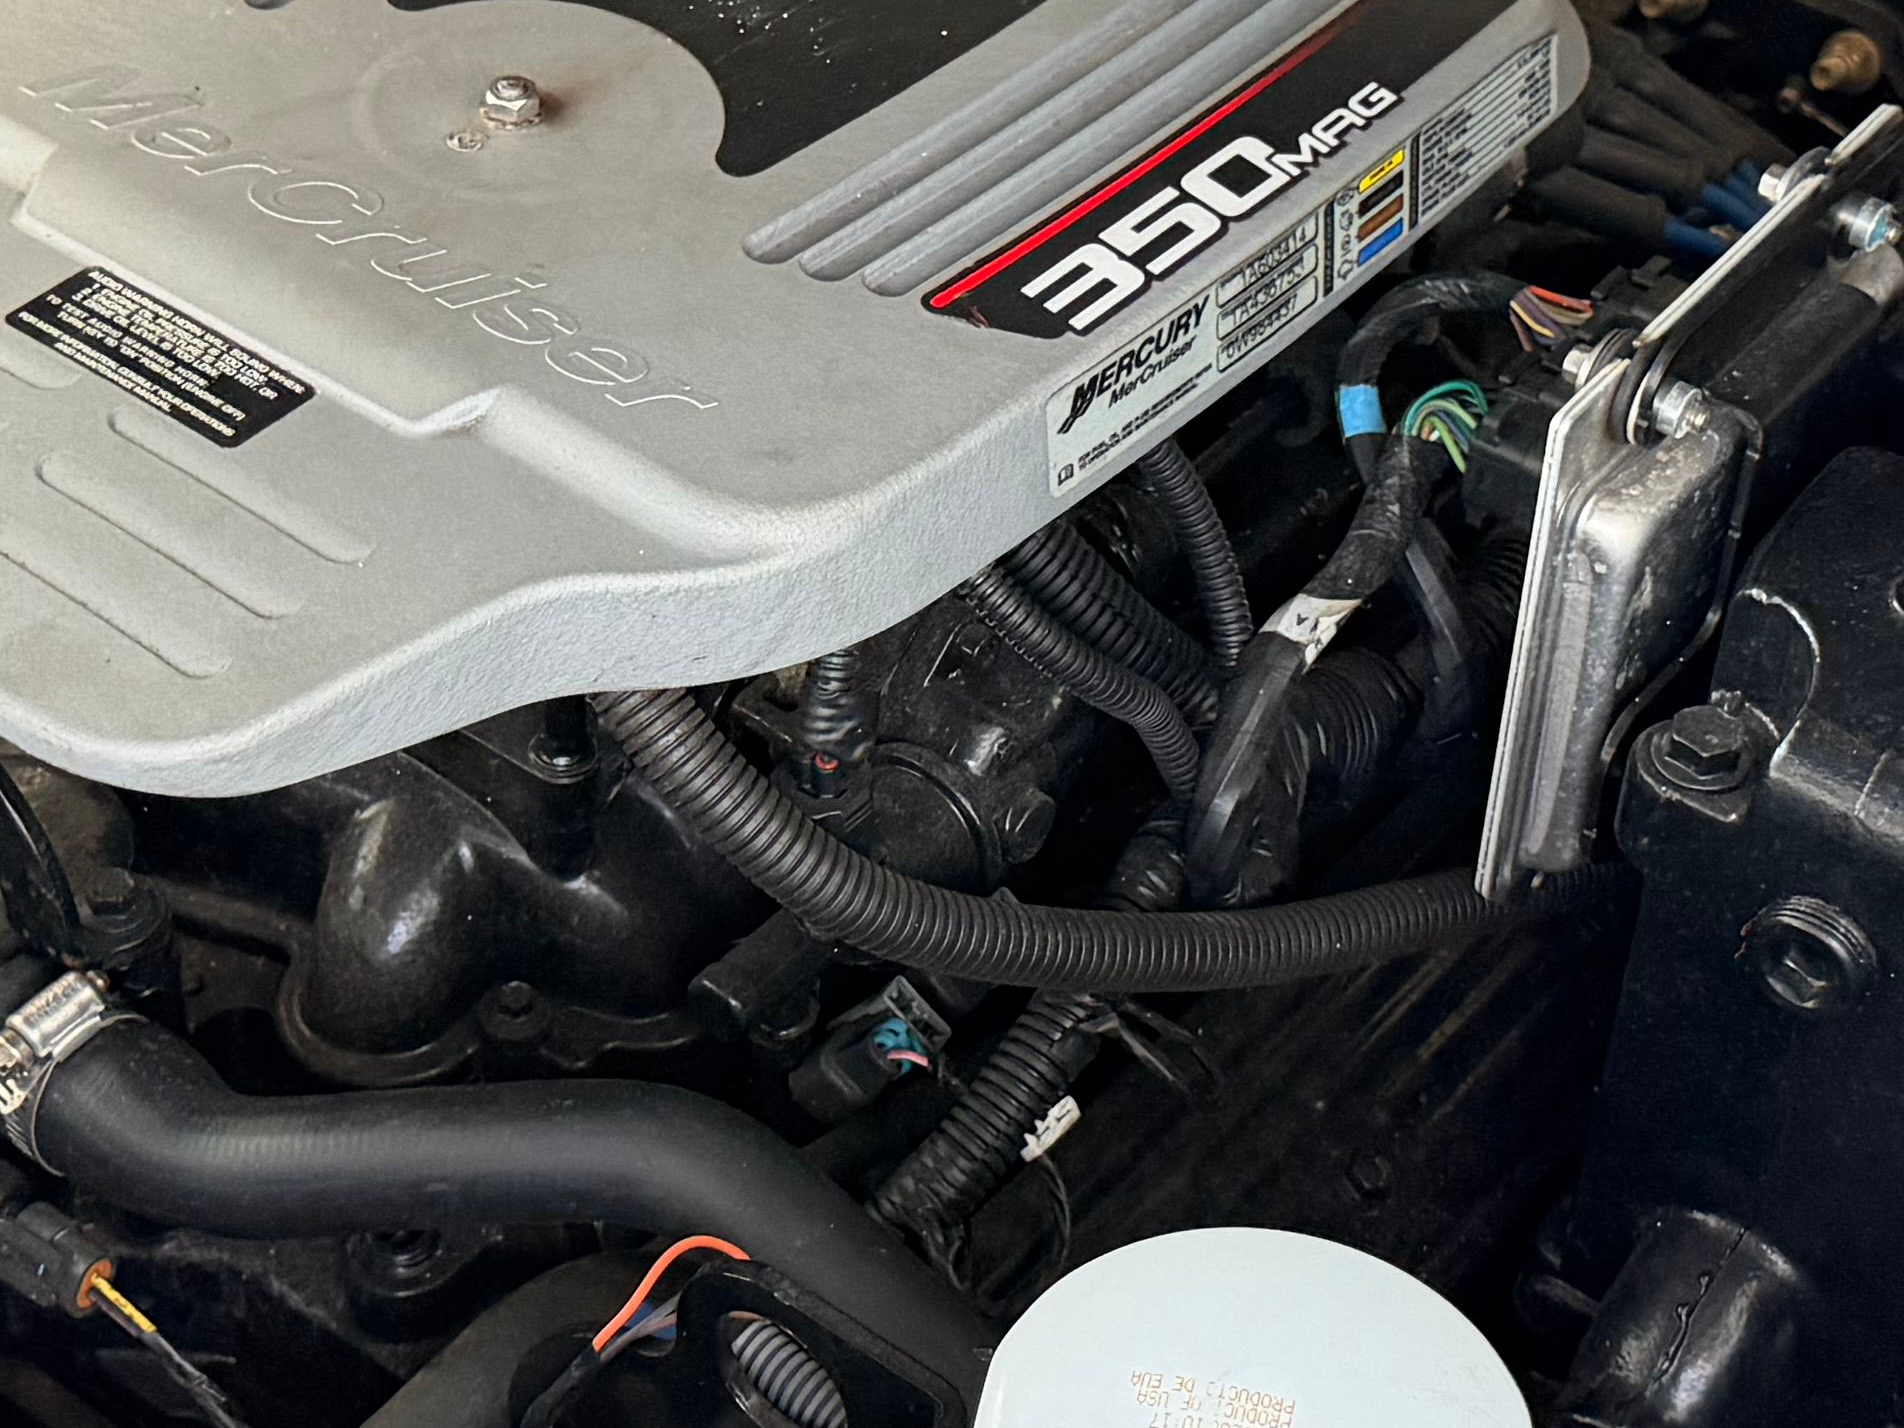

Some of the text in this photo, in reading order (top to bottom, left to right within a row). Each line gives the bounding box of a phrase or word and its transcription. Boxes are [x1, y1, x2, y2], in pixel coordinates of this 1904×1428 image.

[18, 64, 720, 409] MerCruiser
[1021, 136, 1292, 330] 350
[1272, 82, 1398, 176] MAG
[1057, 294, 1209, 434] MERCURY
[1108, 337, 1196, 408] MerCruiser
[1131, 1371, 1163, 1389] EUA
[1136, 1389, 1170, 1409] USA
[1172, 1375, 1196, 1393] DE
